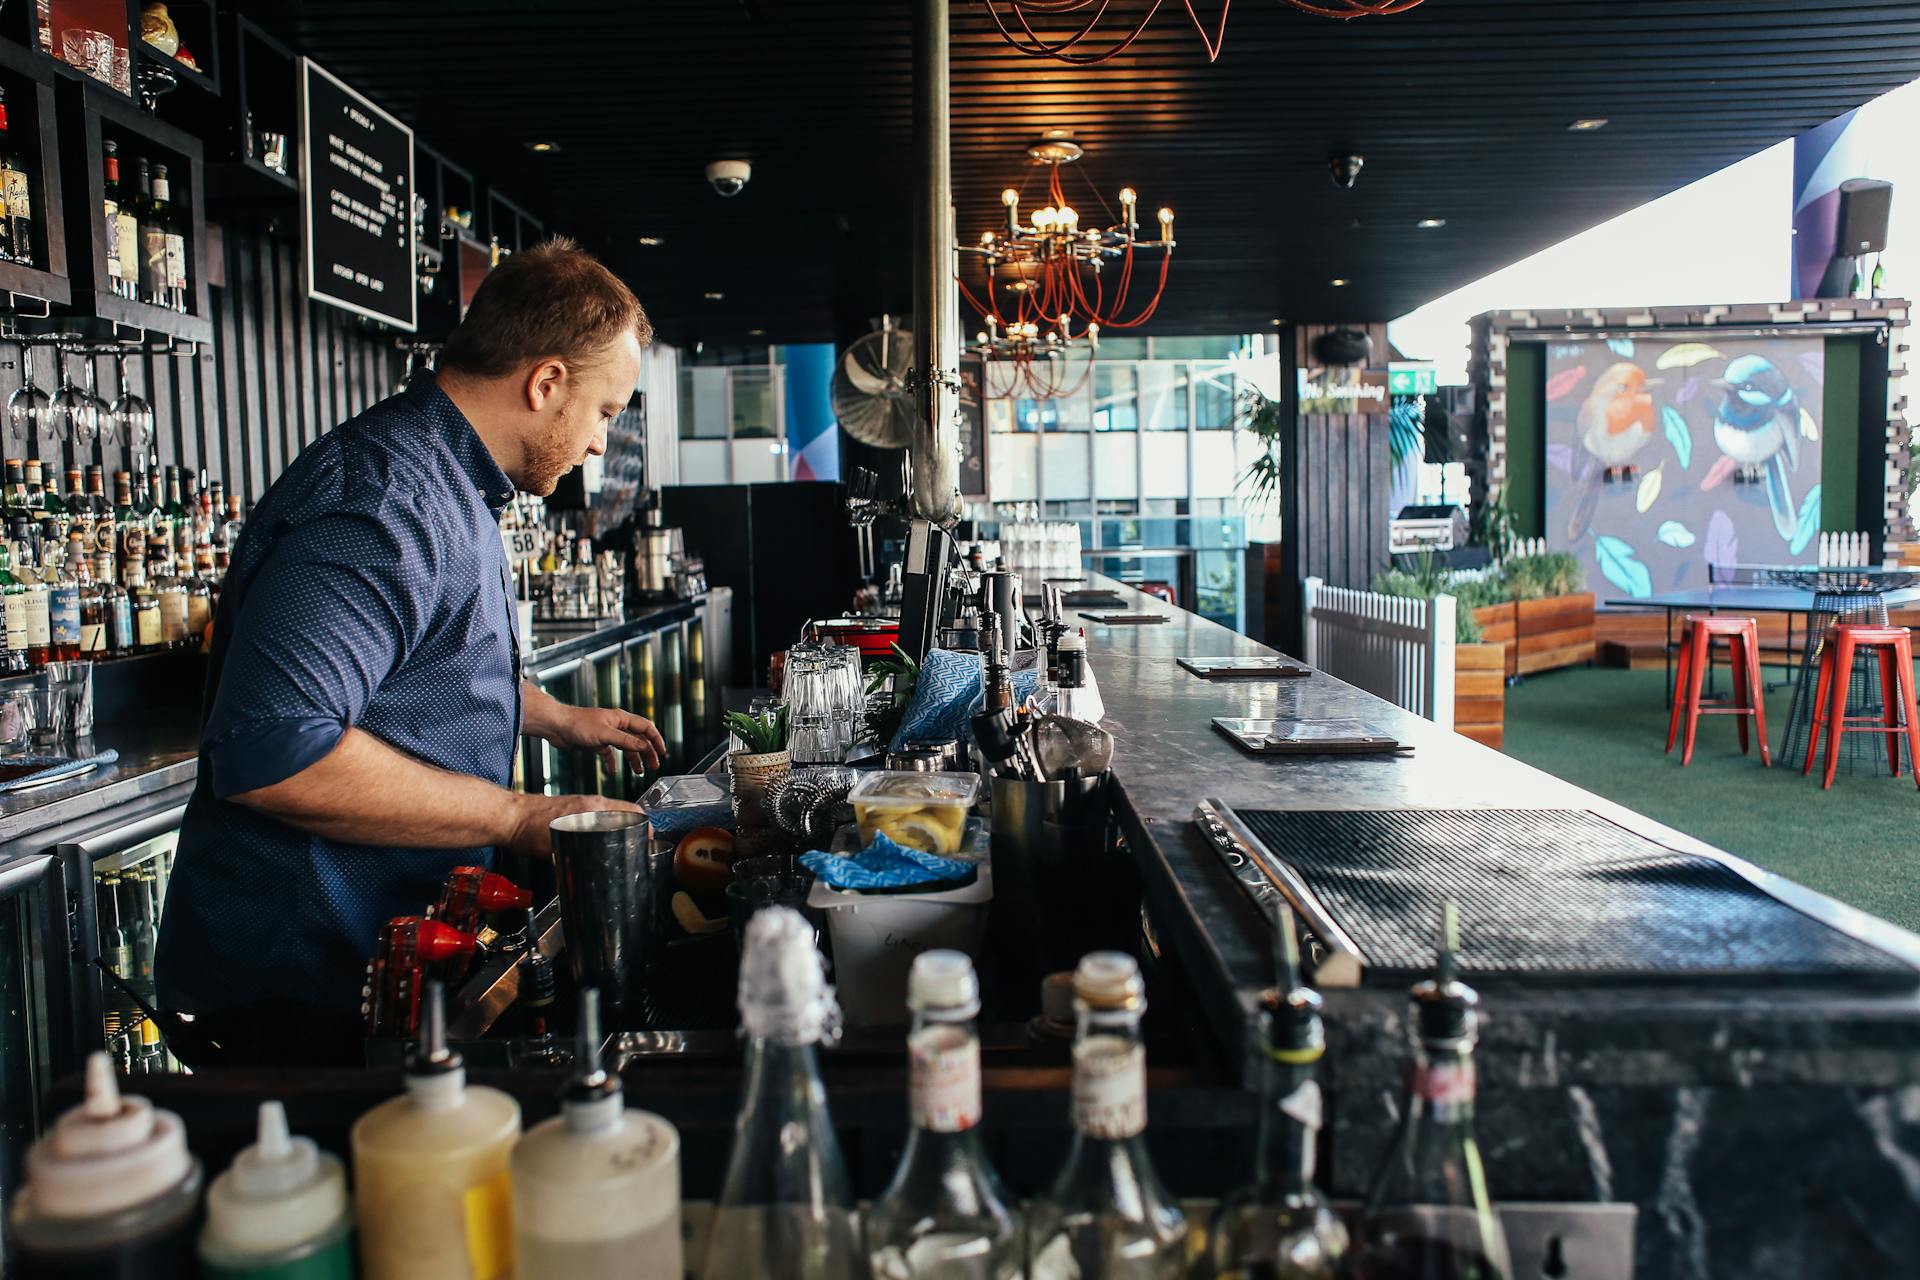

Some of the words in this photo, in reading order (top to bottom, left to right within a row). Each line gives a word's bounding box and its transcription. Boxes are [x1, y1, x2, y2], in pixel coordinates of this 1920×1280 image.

[1303, 382, 1323, 399] No
[1326, 382, 1385, 402] Smoking
[512, 532, 535, 554] 58
